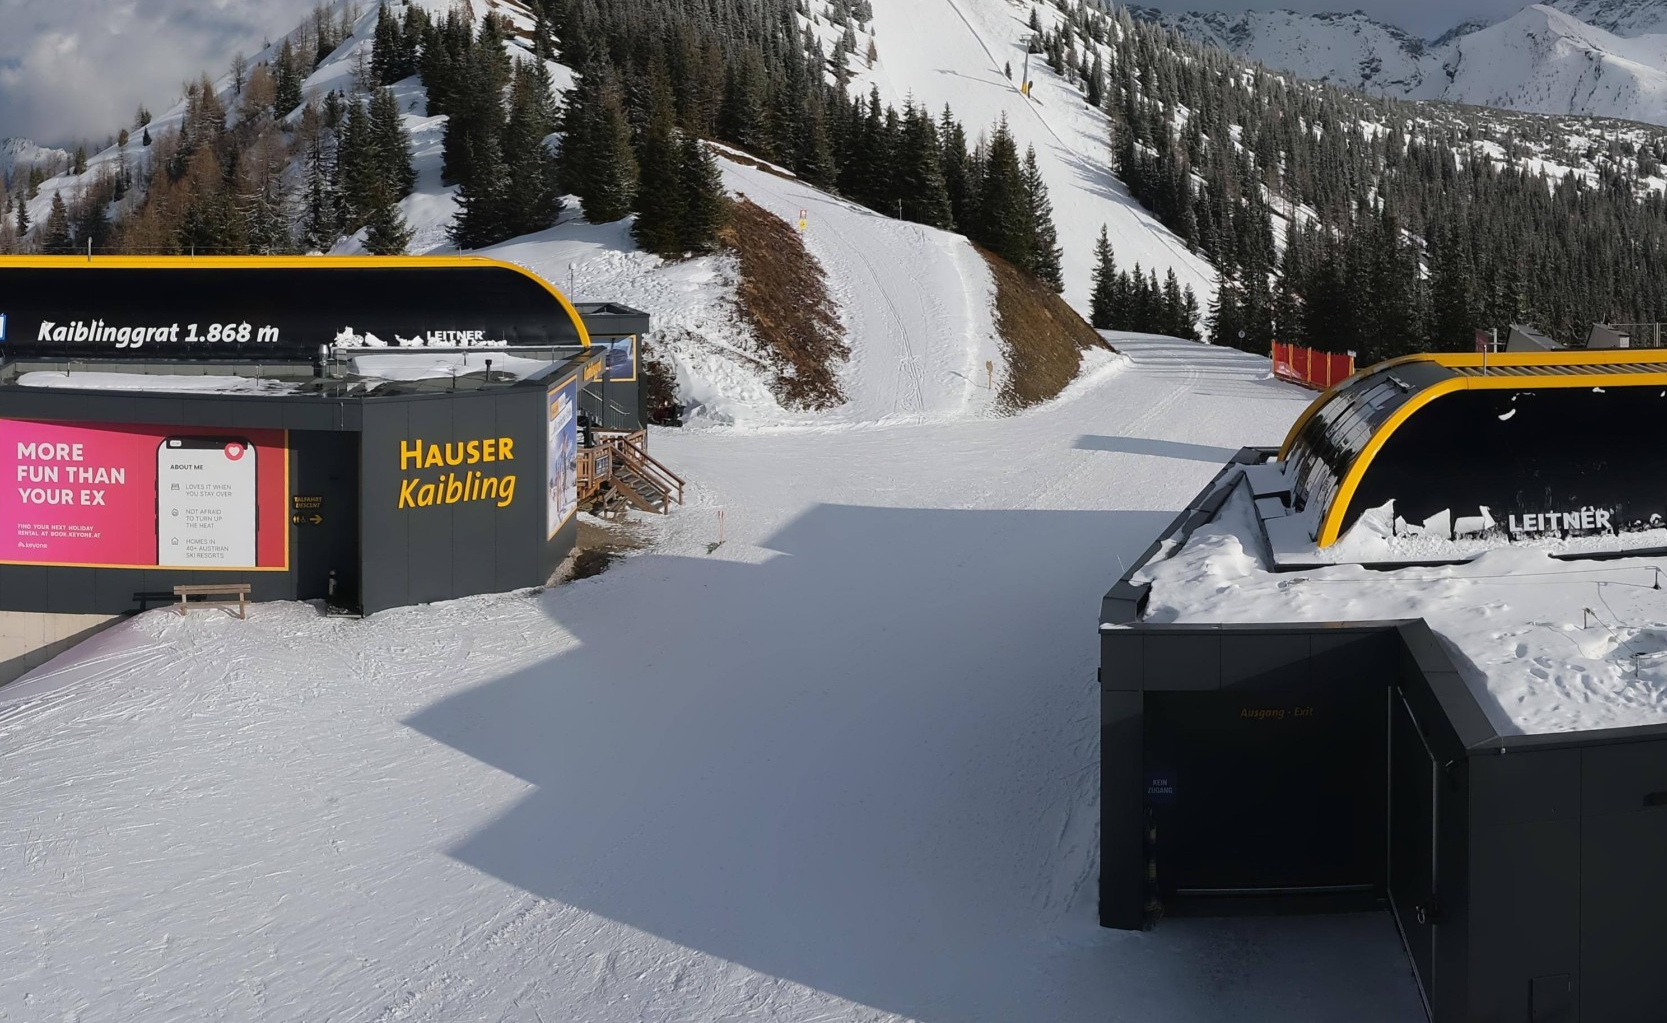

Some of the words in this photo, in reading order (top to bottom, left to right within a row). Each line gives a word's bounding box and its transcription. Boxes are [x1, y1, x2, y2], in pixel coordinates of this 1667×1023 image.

[37, 321, 180, 349] Kaiblinggrat
[184, 323, 252, 343] 1.868
[257, 326, 280, 342] m
[427, 330, 485, 341] LEITNER
[17, 442, 84, 461] MORE
[400, 437, 514, 470] HAUSER
[17, 465, 59, 483] FUN
[66, 466, 125, 484] THAN
[18, 488, 74, 505] YOUR
[80, 489, 106, 506] EX
[398, 471, 516, 509] Kaibling
[1509, 510, 1612, 532] LEITNER
[1240, 708, 1285, 720] Ausgang
[1153, 778, 1168, 786] KEIN
